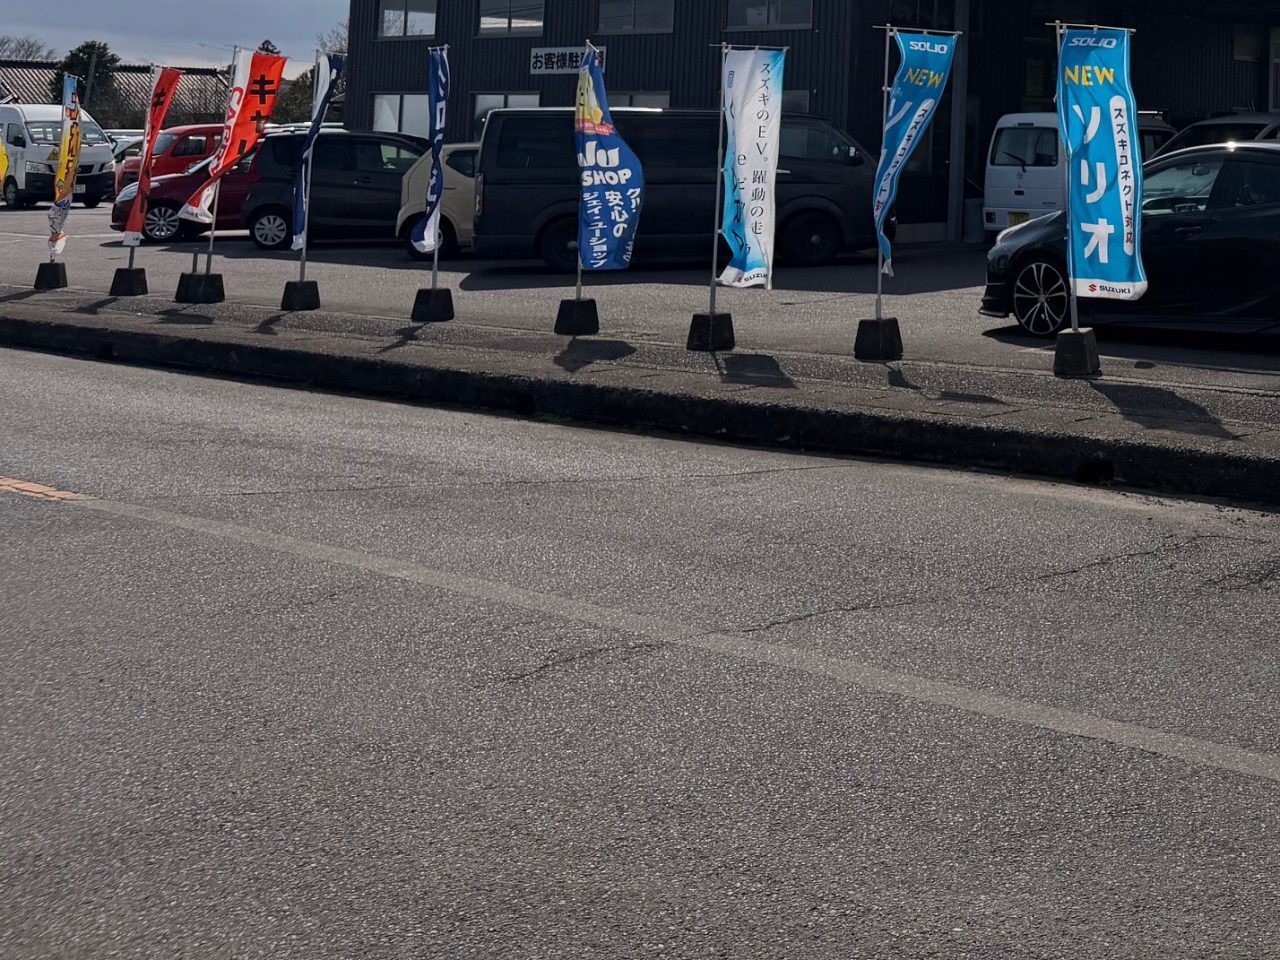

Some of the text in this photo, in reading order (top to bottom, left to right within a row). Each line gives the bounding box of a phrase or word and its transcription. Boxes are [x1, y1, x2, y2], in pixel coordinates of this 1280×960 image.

[909, 41, 948, 54] SOLIO
[1068, 36, 1118, 48] SOLIO
[532, 51, 604, 70] お客様駐
[903, 68, 944, 89] NEW
[1064, 64, 1115, 86] NEW
[582, 168, 632, 186] SHOP
[1073, 104, 1115, 263] ソリオ
[605, 190, 629, 237] 安心の
[1099, 285, 1131, 294] SUZUKI
